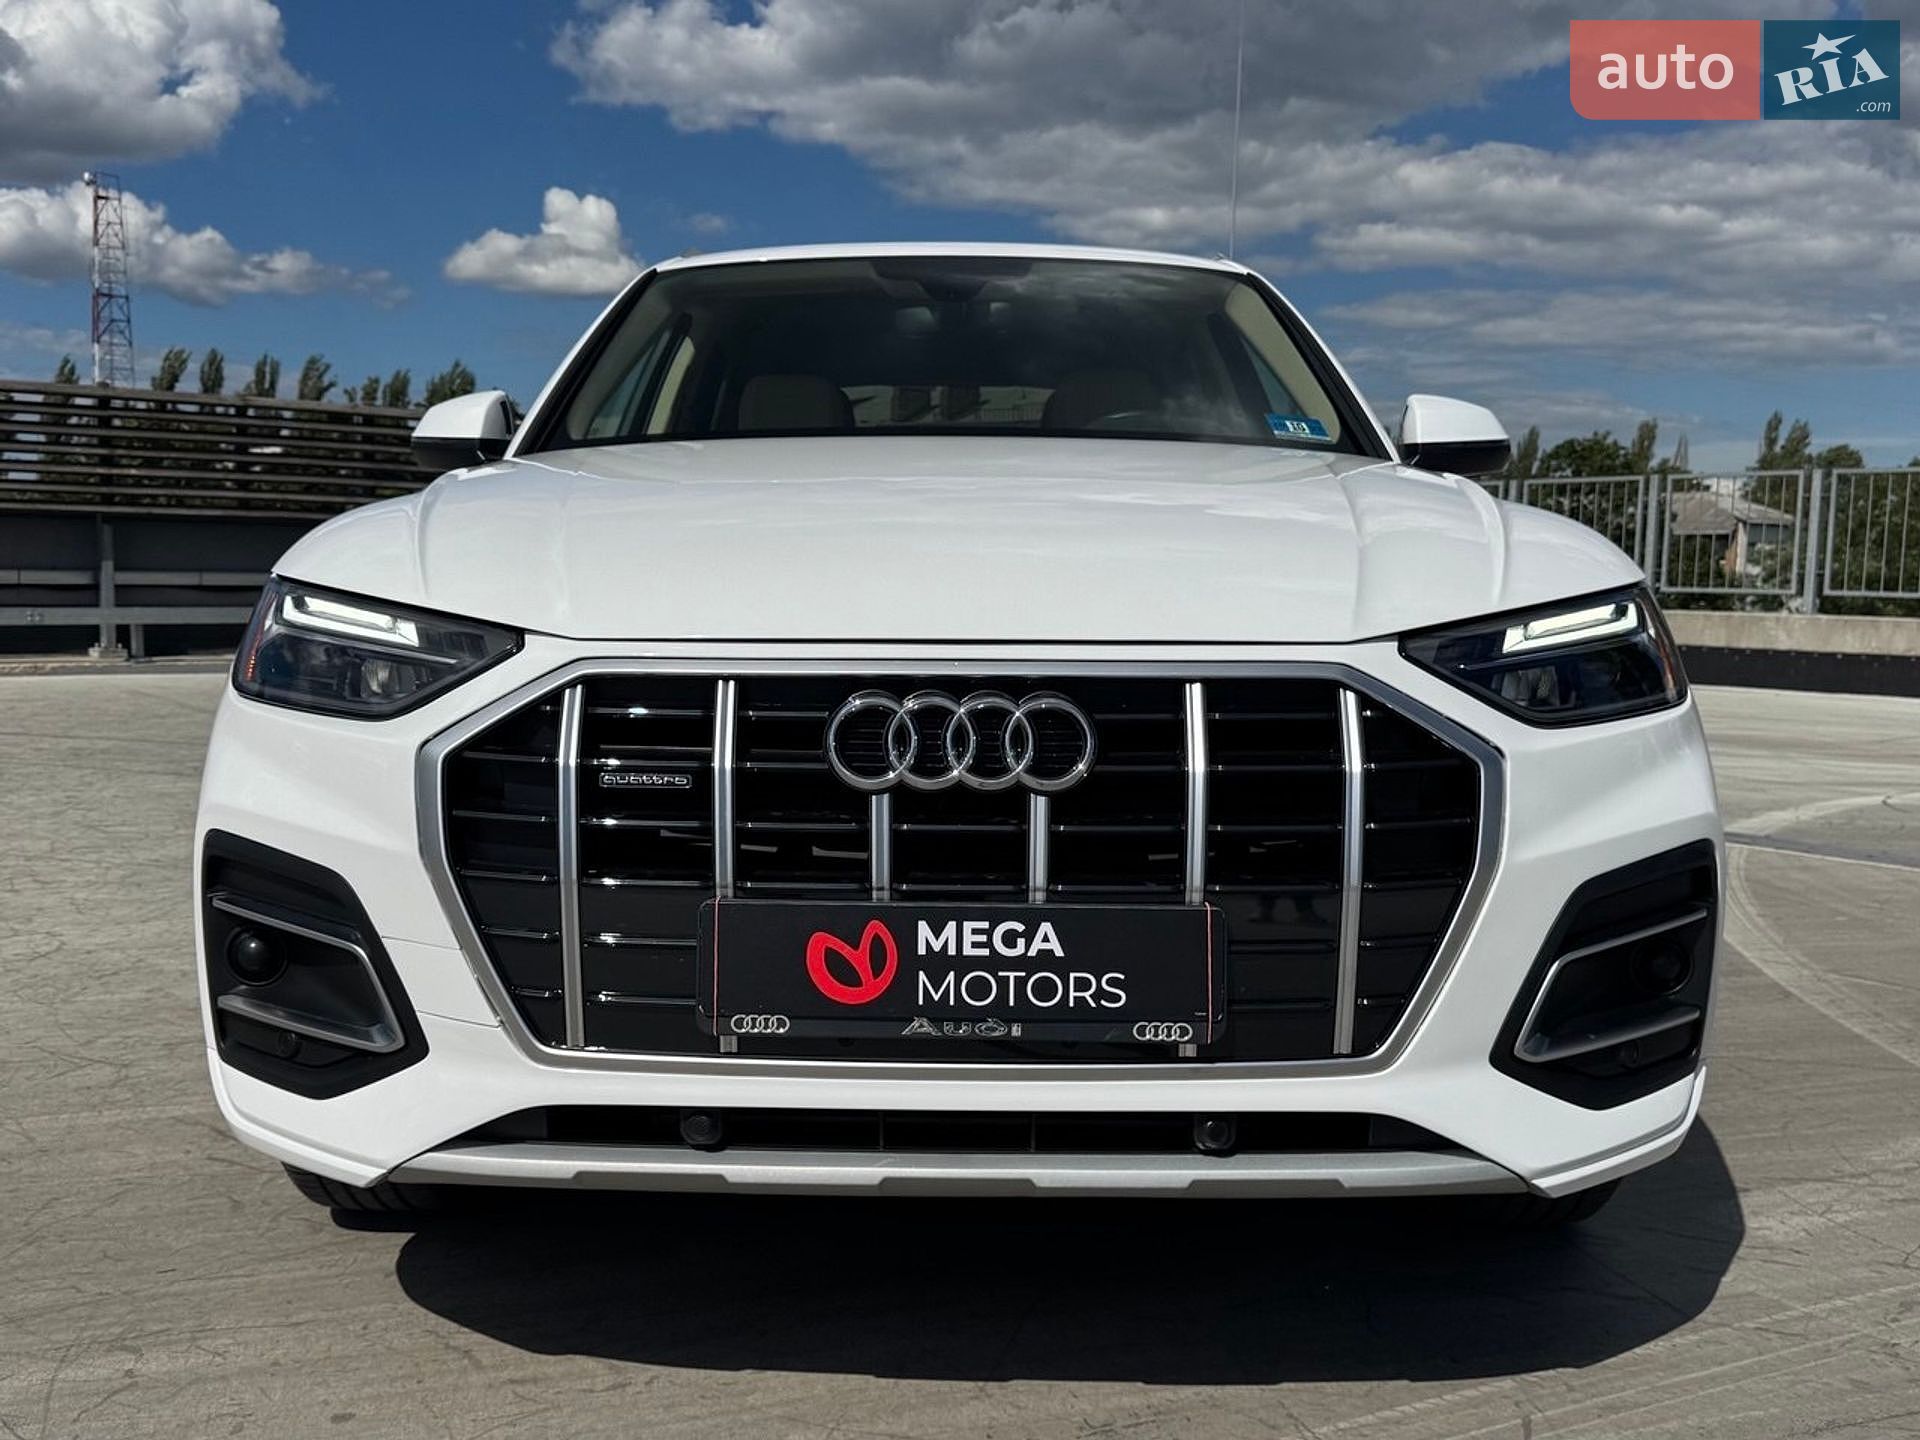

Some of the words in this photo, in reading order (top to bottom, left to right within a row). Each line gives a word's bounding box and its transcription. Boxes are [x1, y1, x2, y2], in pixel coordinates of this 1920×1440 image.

[602, 775, 688, 785] quattro
[917, 920, 1065, 957] MEGA
[917, 970, 1127, 1008] MOTORS
